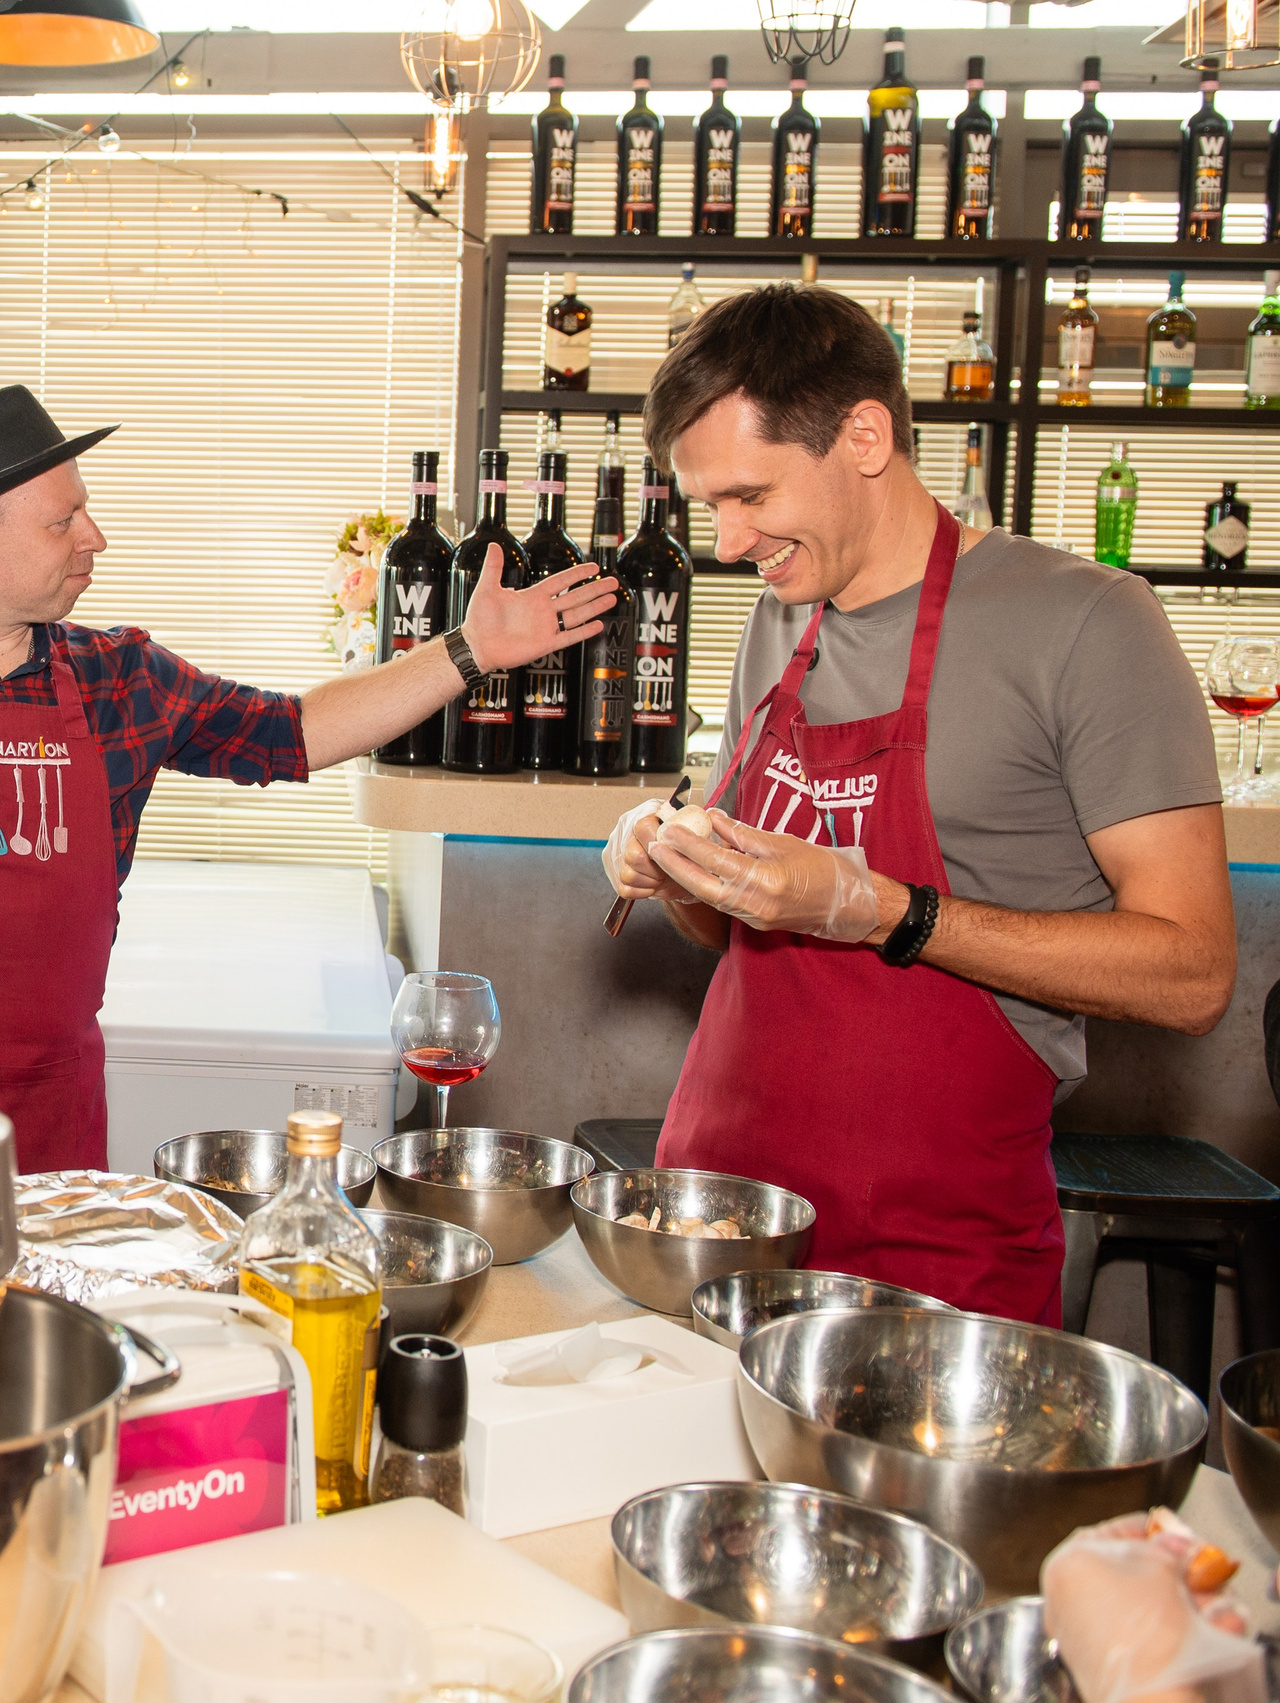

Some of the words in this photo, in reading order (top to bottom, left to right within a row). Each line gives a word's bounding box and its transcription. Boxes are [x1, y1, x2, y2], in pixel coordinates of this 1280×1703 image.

[396, 584, 432, 615] W
[642, 590, 679, 621] W
[393, 616, 431, 636] INE
[639, 624, 677, 643] INE
[637, 656, 673, 676] ON
[109, 1468, 244, 1519] EventyOn
